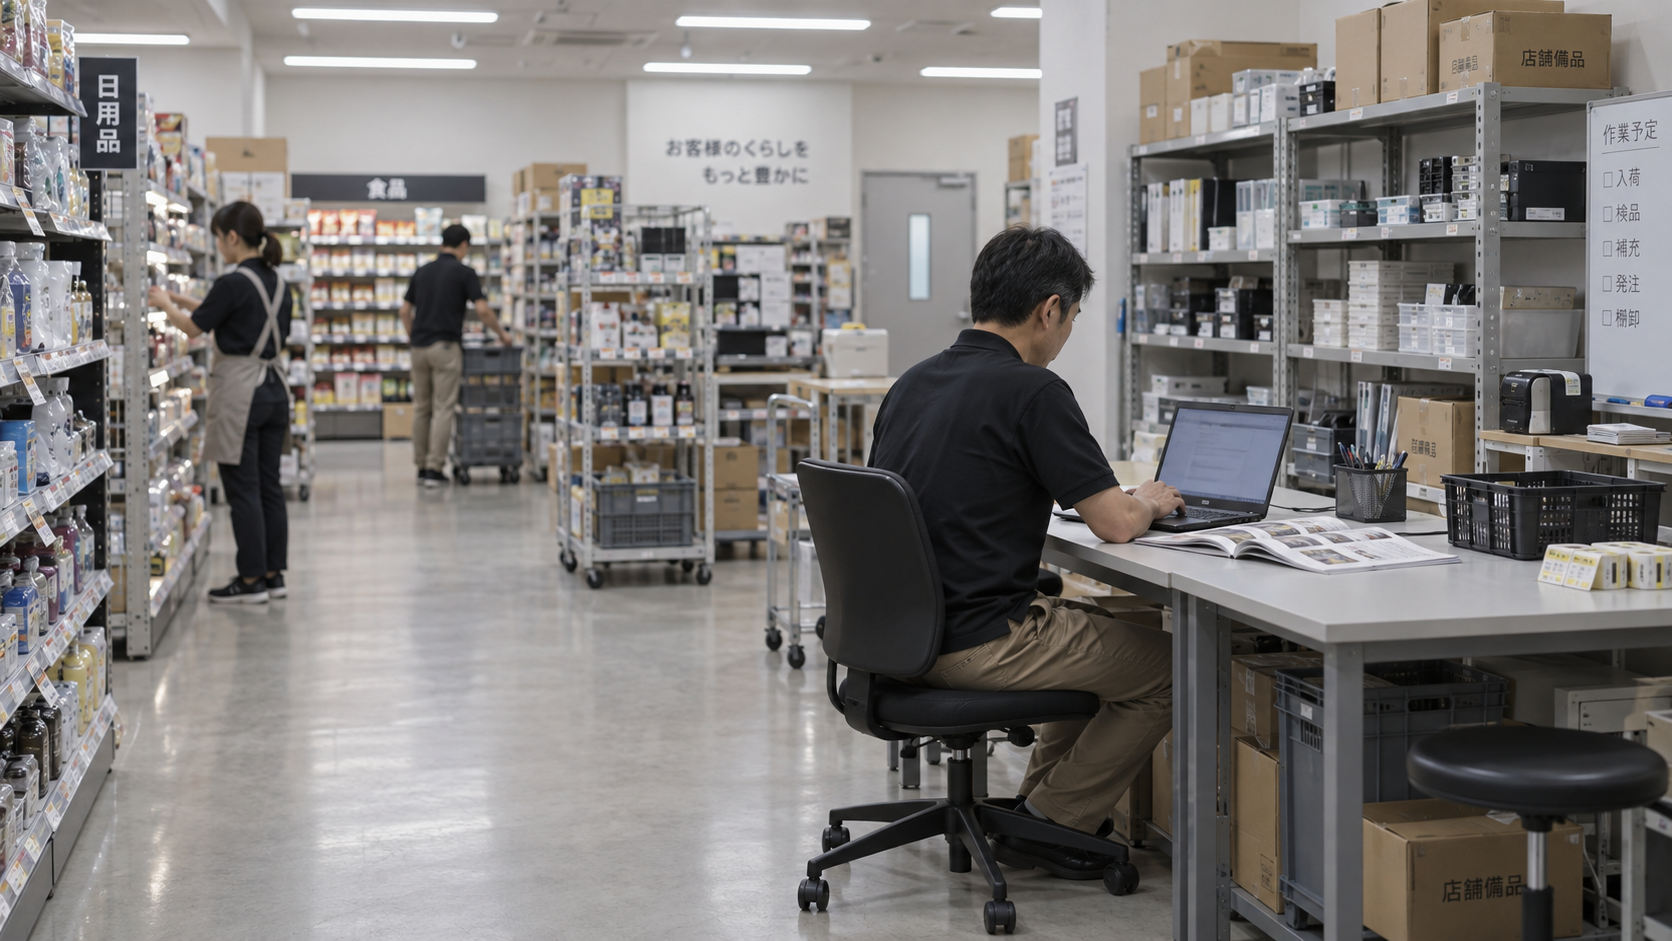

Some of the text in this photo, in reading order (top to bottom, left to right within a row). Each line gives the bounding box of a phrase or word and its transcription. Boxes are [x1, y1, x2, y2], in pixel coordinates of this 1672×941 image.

[1521, 49, 1585, 68] 店舗備品
[96, 74, 120, 153] 日用品
[1603, 119, 1658, 145] 作業予定
[666, 139, 809, 158] お客様のくらしを
[703, 166, 809, 185] もっと豊かに
[1616, 168, 1640, 188] 入荷
[366, 177, 408, 200] 食品
[1616, 203, 1640, 223] 検品
[1616, 238, 1640, 258] 補充
[1616, 274, 1640, 294] 発注
[1615, 309, 1640, 329] 棚卸
[1442, 874, 1522, 903] 店舗備品
